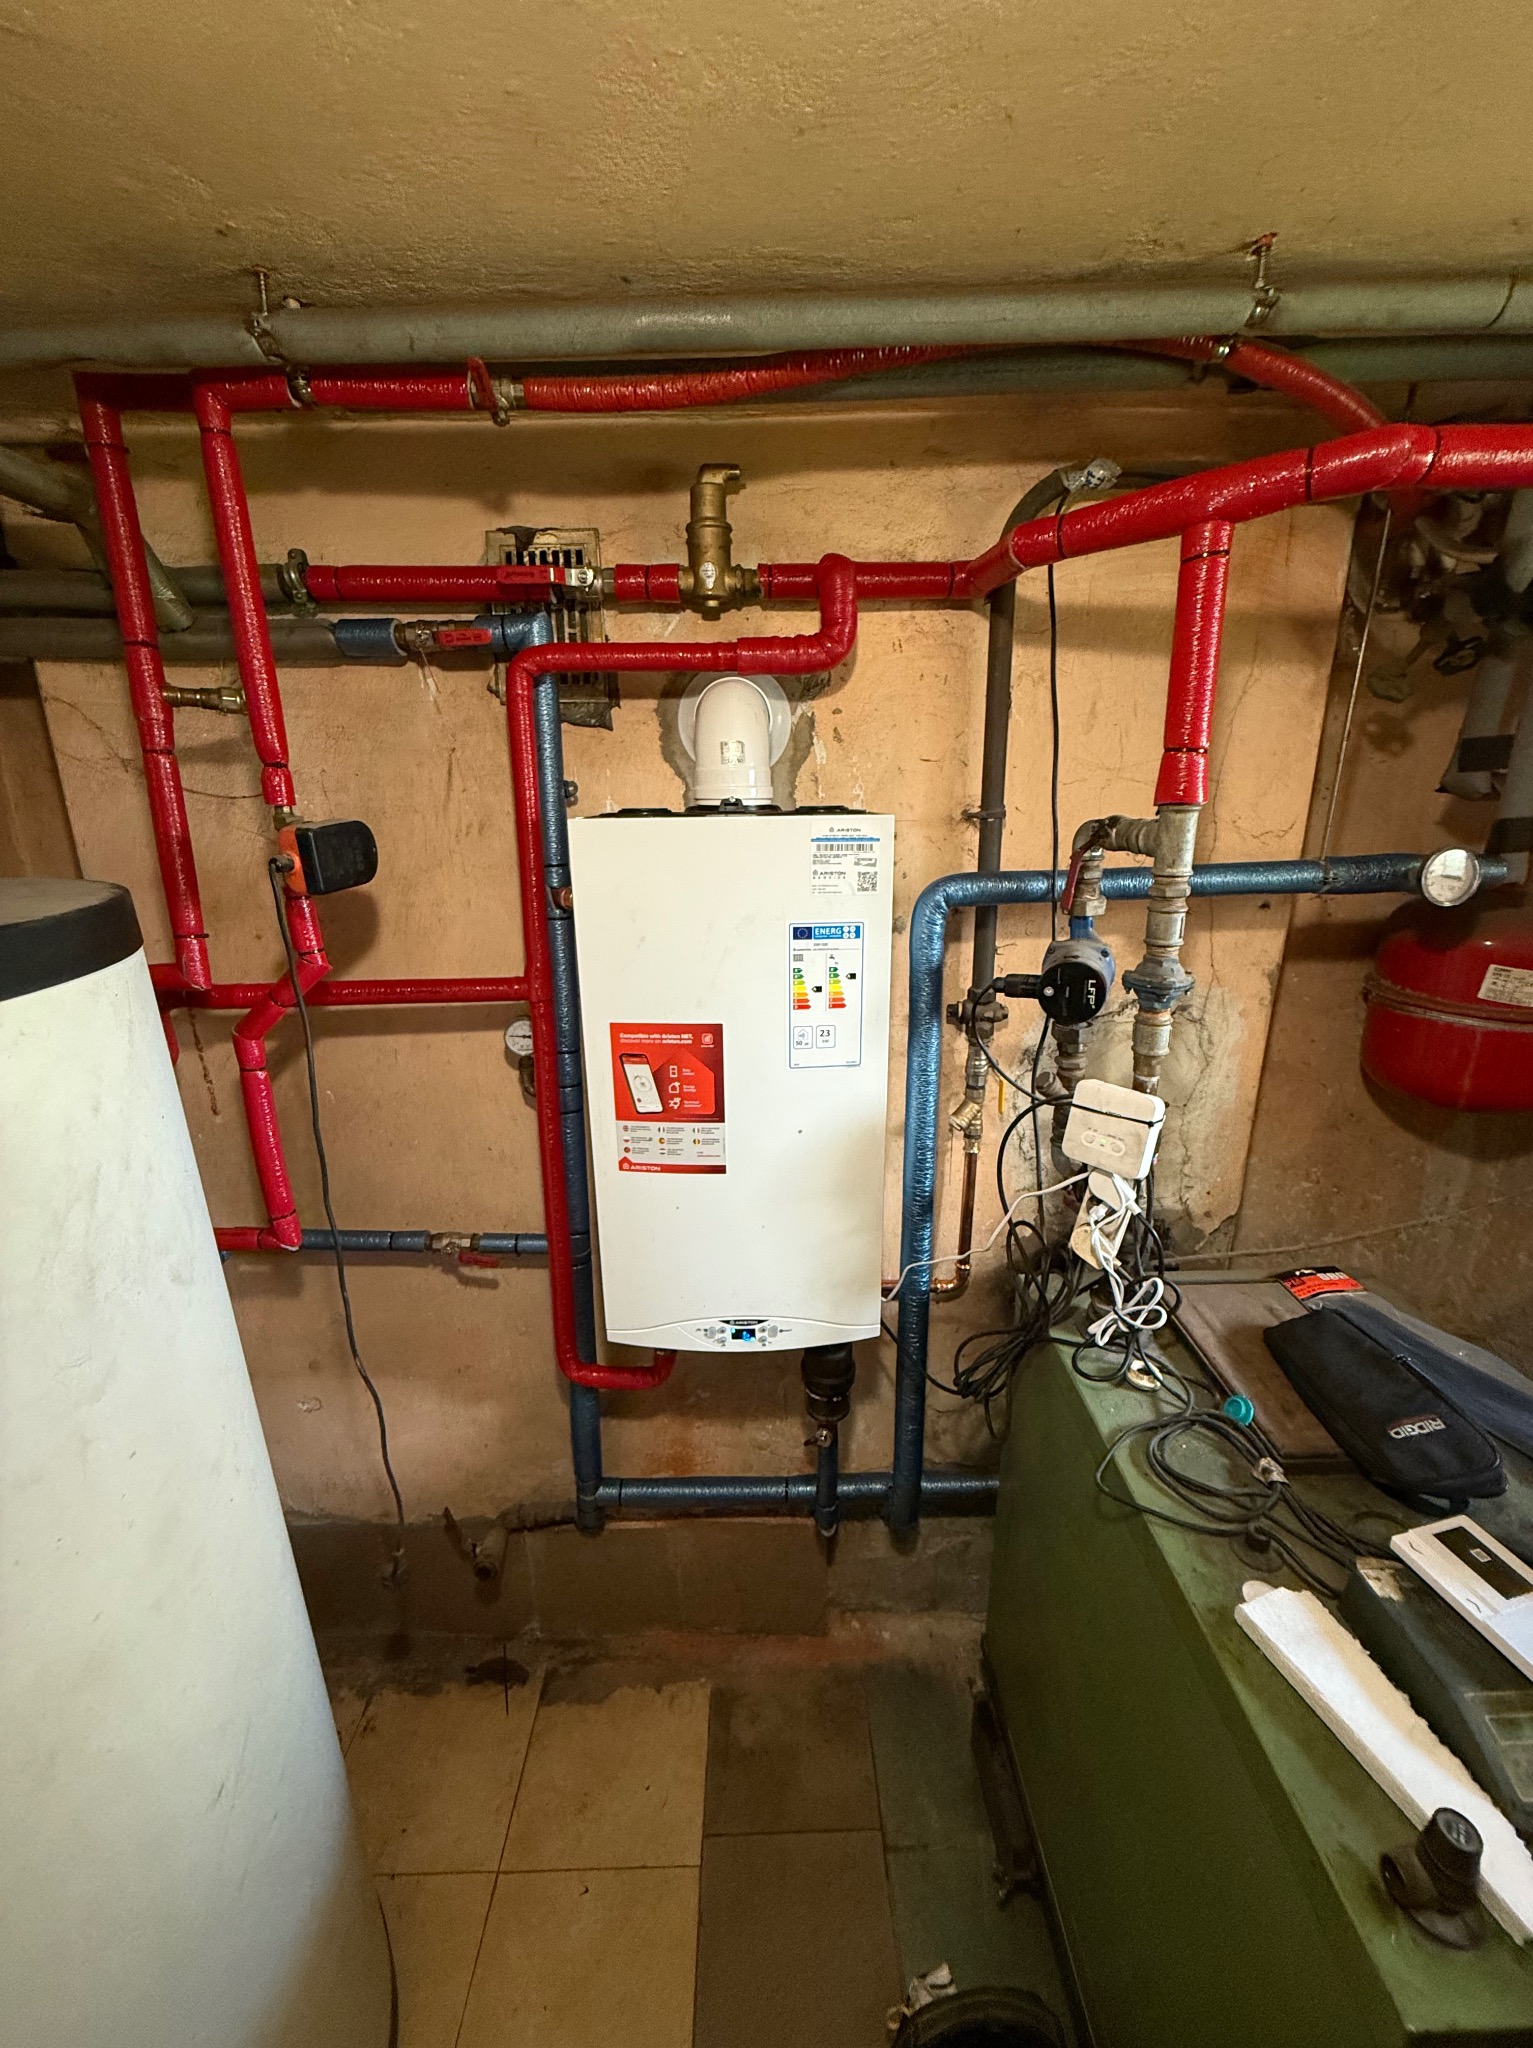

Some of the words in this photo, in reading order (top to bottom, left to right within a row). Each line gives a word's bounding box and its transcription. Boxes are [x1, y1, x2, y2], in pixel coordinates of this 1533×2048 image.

[814, 927, 842, 935] ENERG
[1087, 979, 1097, 1006] LFP
[1388, 1418, 1447, 1439] RIDGID
